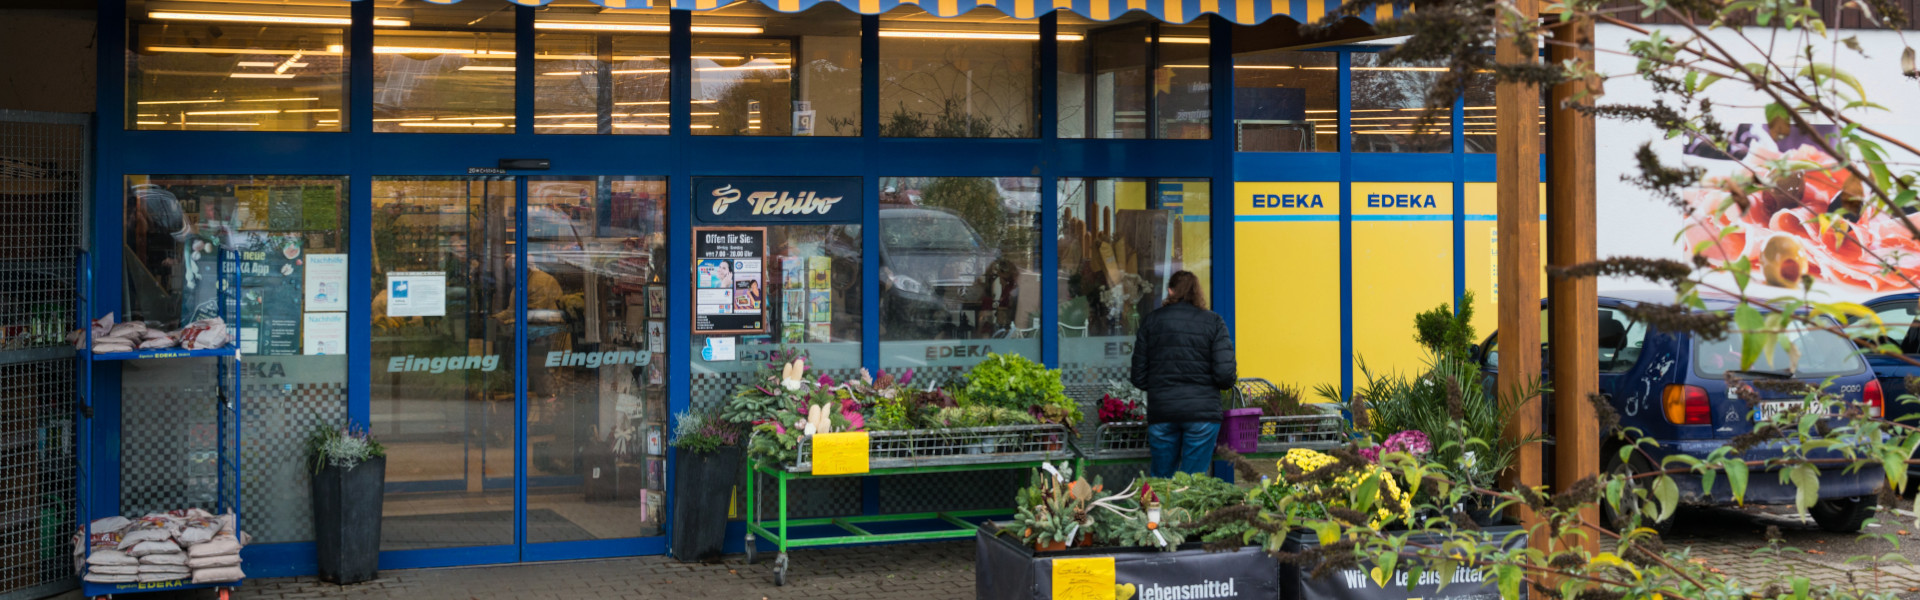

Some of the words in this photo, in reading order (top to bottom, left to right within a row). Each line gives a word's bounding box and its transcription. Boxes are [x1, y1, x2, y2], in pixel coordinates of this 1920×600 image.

[747, 191, 843, 215] Tchibo
[1252, 194, 1324, 208] EDEKA
[1367, 194, 1437, 208] EDEKA
[706, 234, 726, 244] Offen
[727, 234, 739, 244] für
[740, 234, 754, 244] Sie:
[243, 251, 266, 260] neue
[310, 256, 343, 264] Nachhilfe
[251, 262, 270, 277] App
[926, 345, 993, 358] EDEKA
[387, 354, 500, 374] Eingang
[544, 349, 653, 369] Eingang
[137, 579, 183, 590] EDEKA
[1344, 570, 1367, 589] Wir
[1138, 577, 1238, 600] Lebensmittel.
